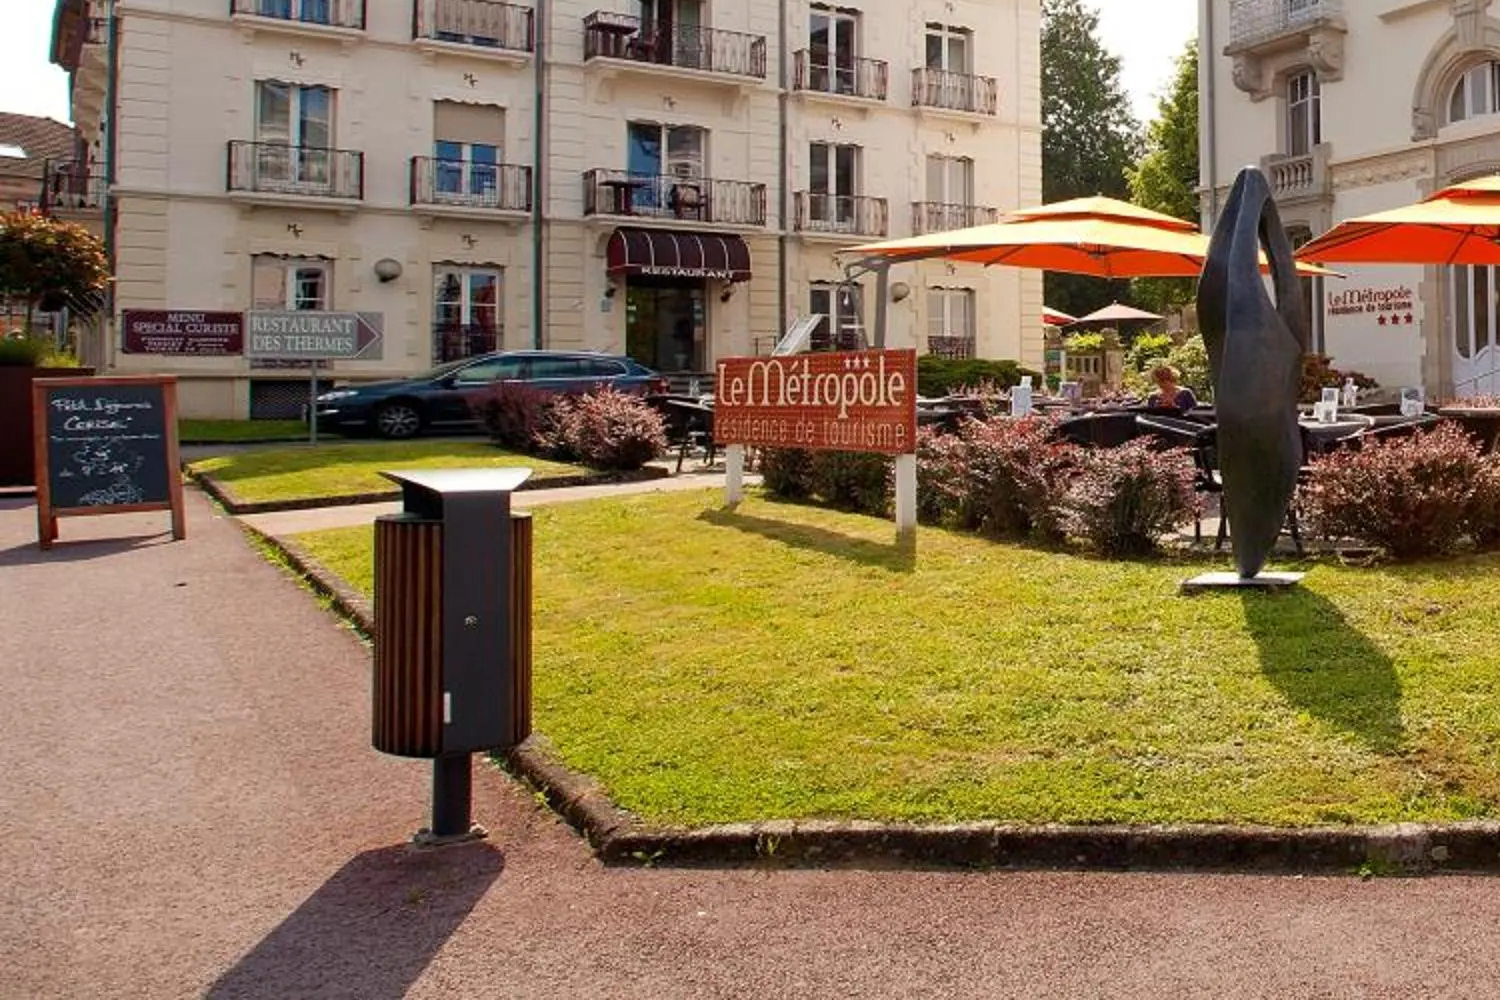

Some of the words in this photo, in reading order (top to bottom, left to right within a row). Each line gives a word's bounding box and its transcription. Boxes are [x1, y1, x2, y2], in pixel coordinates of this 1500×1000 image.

[641, 266, 735, 278] RESTAURANT
[1343, 286, 1412, 304] Métropole
[167, 313, 205, 323] MENU
[251, 317, 353, 334] RESTAURANT
[253, 334, 281, 351] DES
[284, 335, 354, 353] THERMES
[718, 363, 744, 406] Le
[747, 355, 905, 419] Métropole
[715, 412, 788, 442] résidence
[795, 415, 815, 444] de
[823, 416, 906, 449] tourisme
